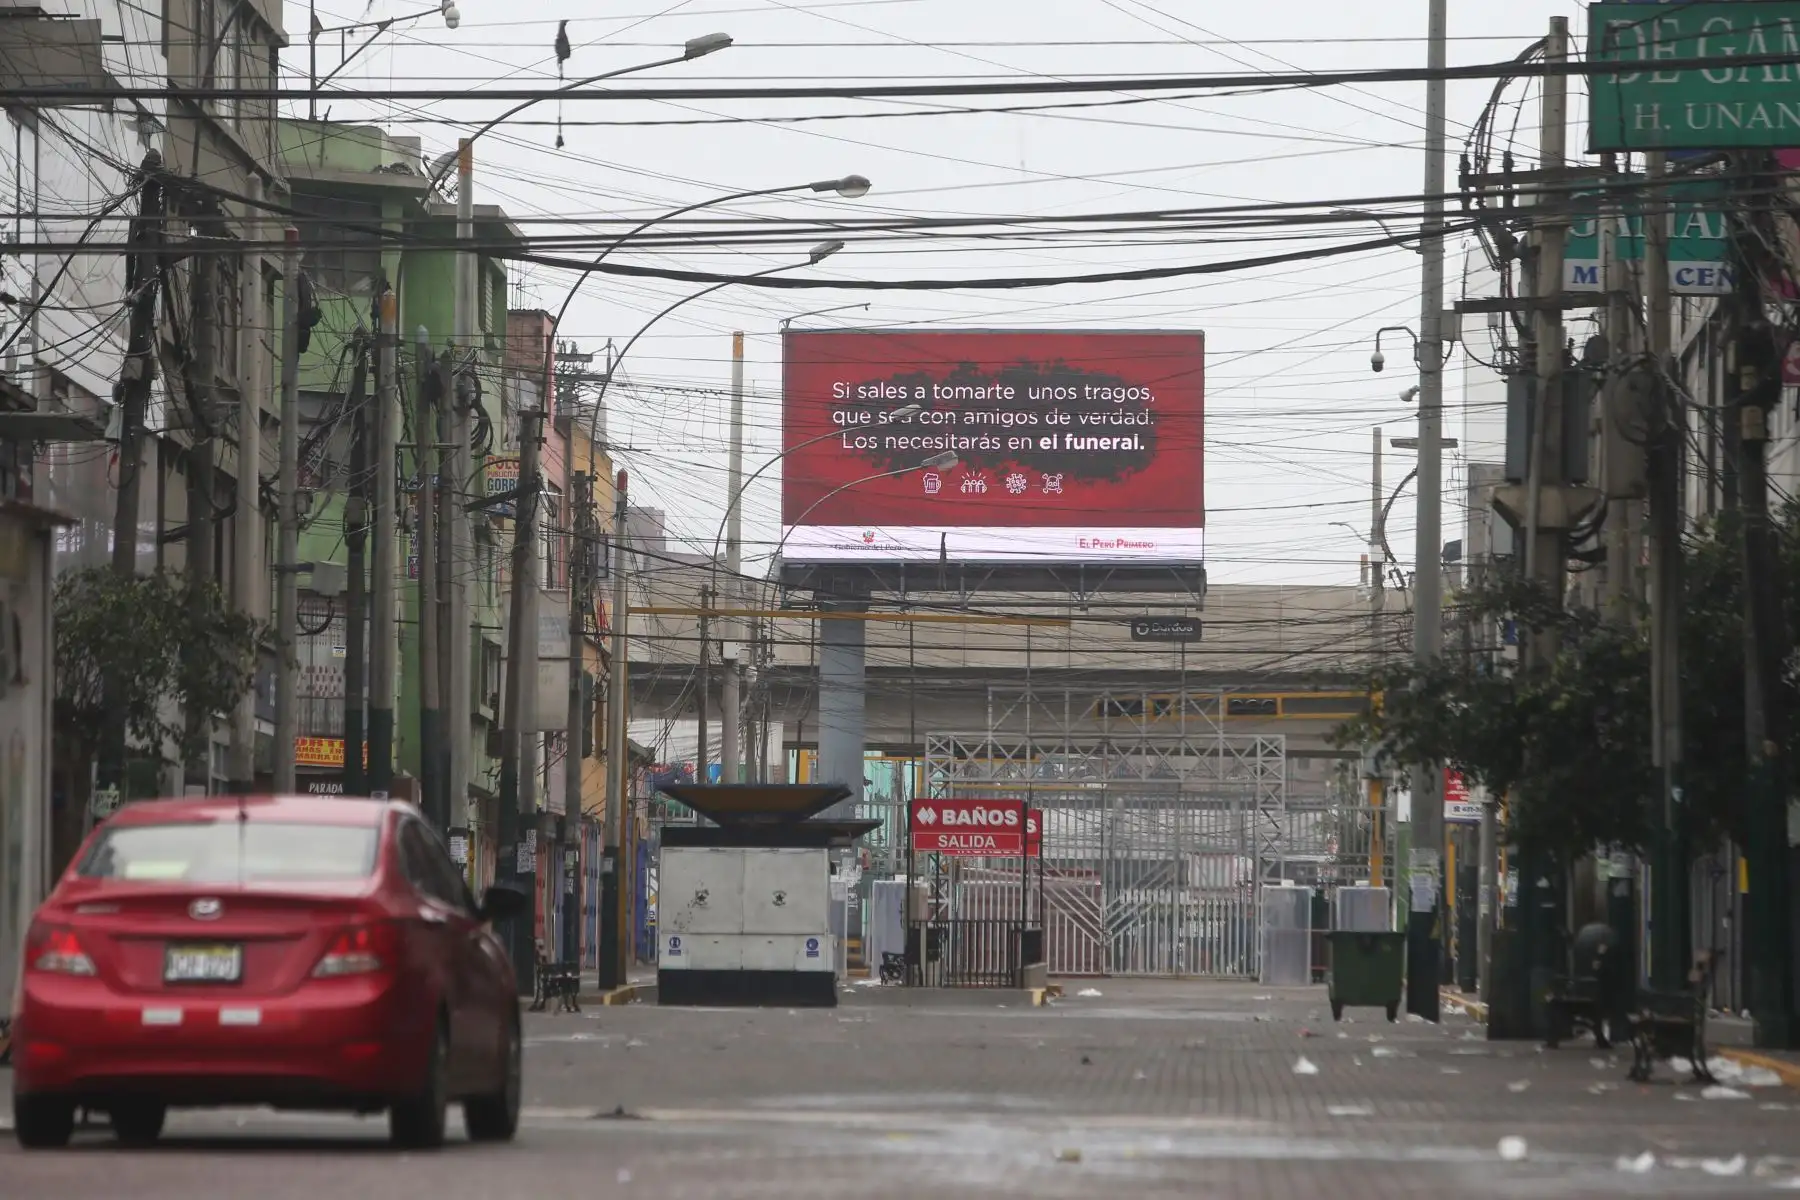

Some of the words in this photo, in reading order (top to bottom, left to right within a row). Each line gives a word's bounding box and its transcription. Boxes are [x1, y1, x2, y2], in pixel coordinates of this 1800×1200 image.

[1608, 18, 1680, 84] DE
[1634, 103, 1671, 130] H.
[1685, 102, 1800, 130] UNAN
[832, 382, 850, 399] Si
[858, 382, 908, 399] sales
[914, 386, 926, 399] a
[933, 384, 1015, 400] tomarte
[1028, 387, 1077, 400] unos
[1084, 384, 1155, 403] tragos,
[832, 410, 871, 426] que
[919, 411, 956, 424] con
[963, 408, 1038, 427] amigos
[1045, 408, 1071, 425] de
[1079, 408, 1154, 425] verdad.
[842, 433, 878, 449] Los
[885, 432, 1001, 449] necesitarás
[1007, 436, 1032, 450] en
[1039, 434, 1058, 450] el
[1065, 434, 1145, 450] funeral.
[309, 783, 343, 794] PARADA
[942, 806, 1019, 826] BAÑOS
[938, 835, 996, 848] SALIDA
